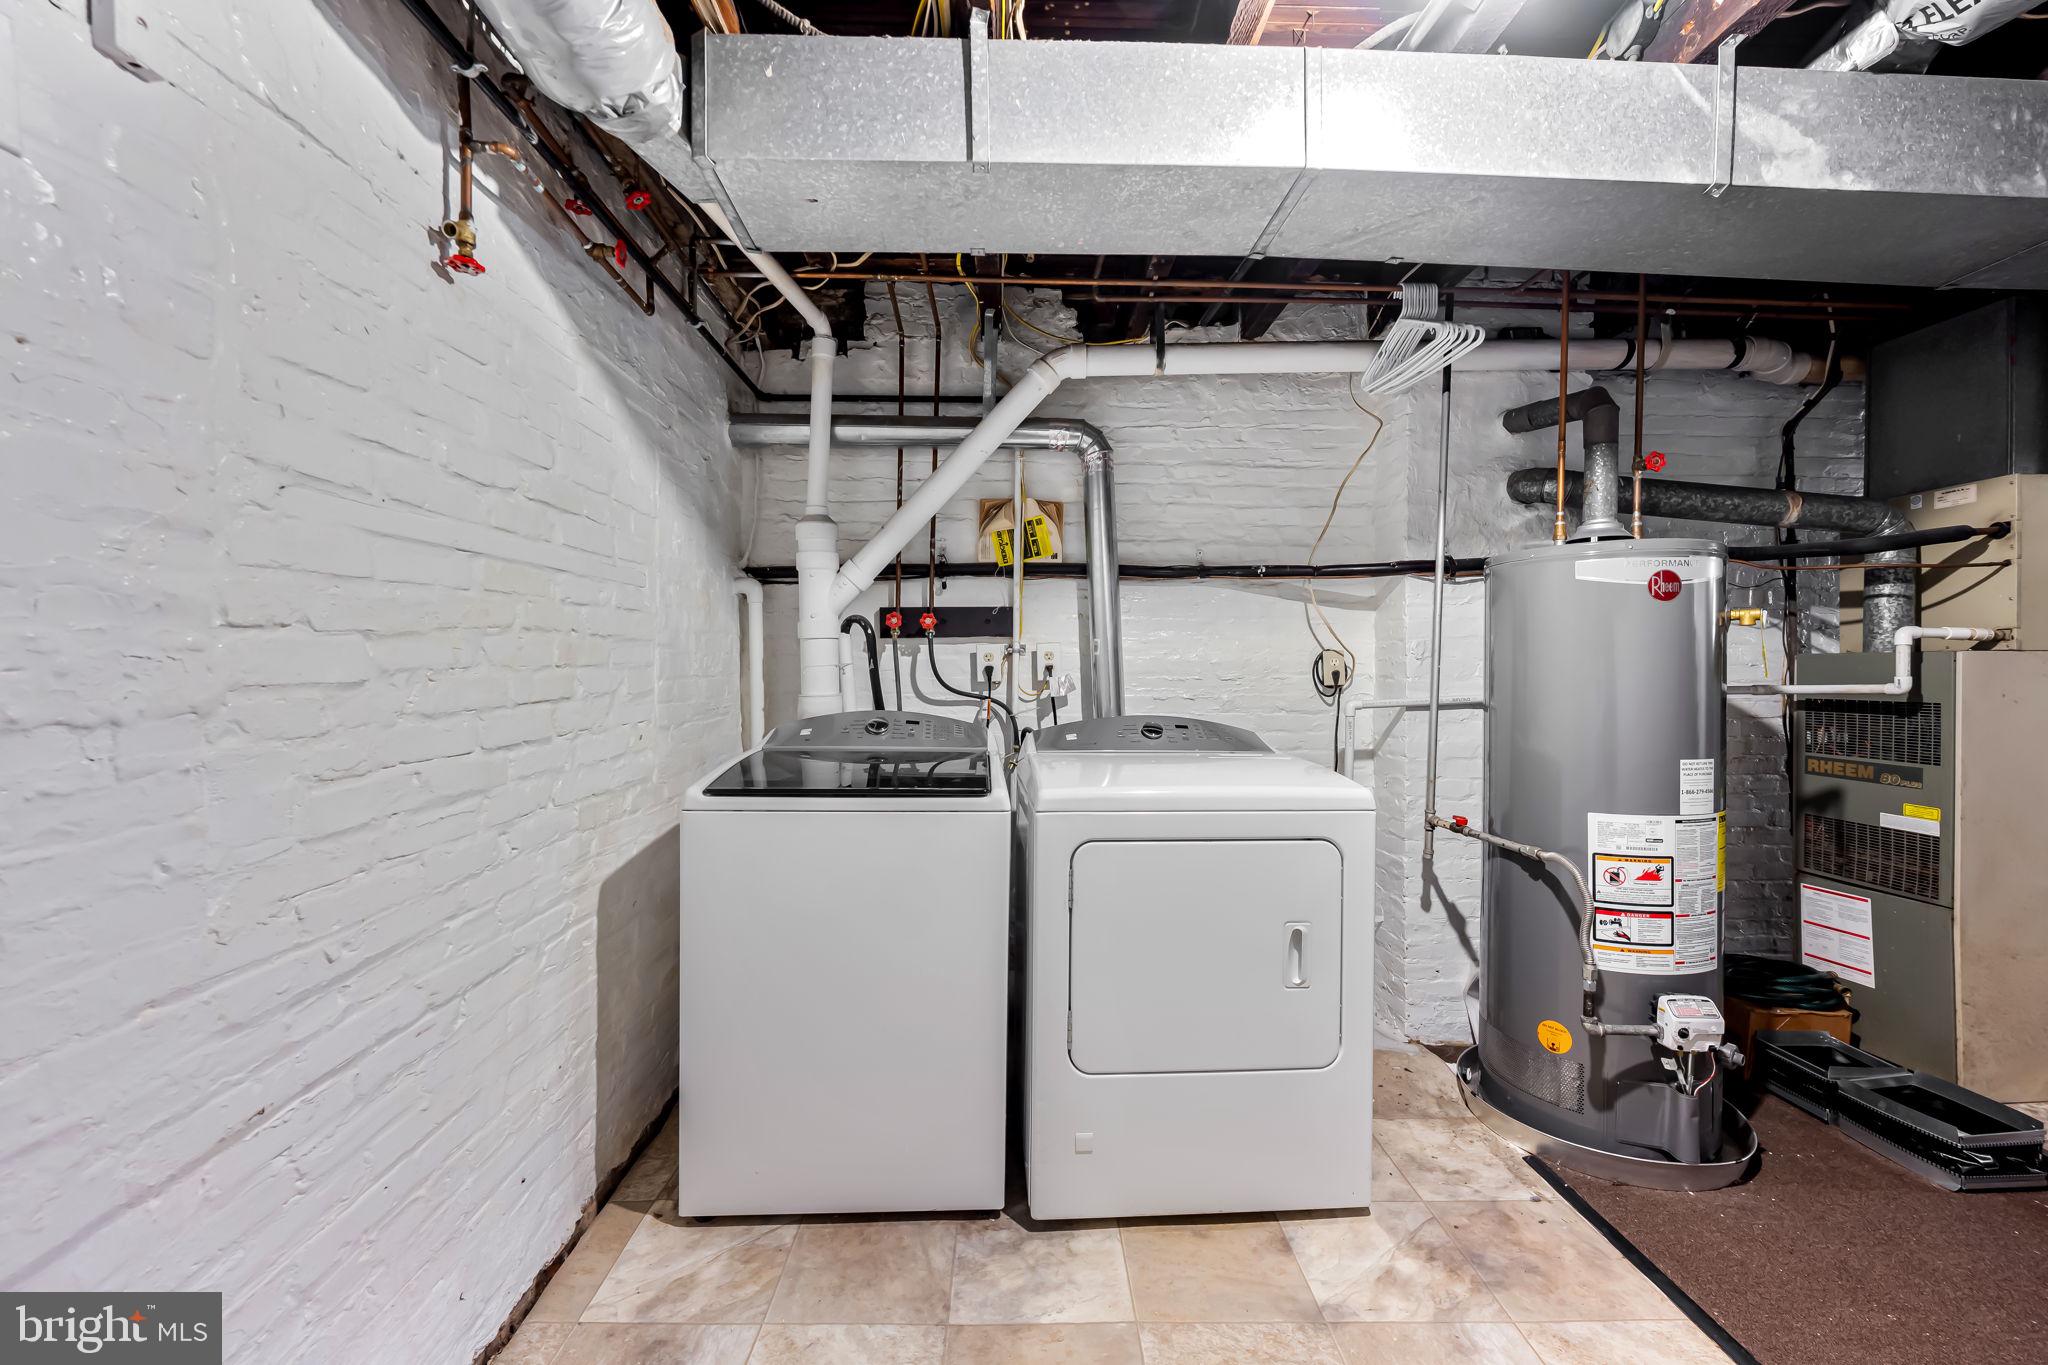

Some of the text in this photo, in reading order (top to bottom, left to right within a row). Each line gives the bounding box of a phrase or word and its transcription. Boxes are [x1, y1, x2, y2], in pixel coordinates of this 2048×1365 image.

[1919, 0, 1982, 24] FLE
[1652, 570, 1680, 597] Rheem
[1807, 758, 1875, 780] RHEEM
